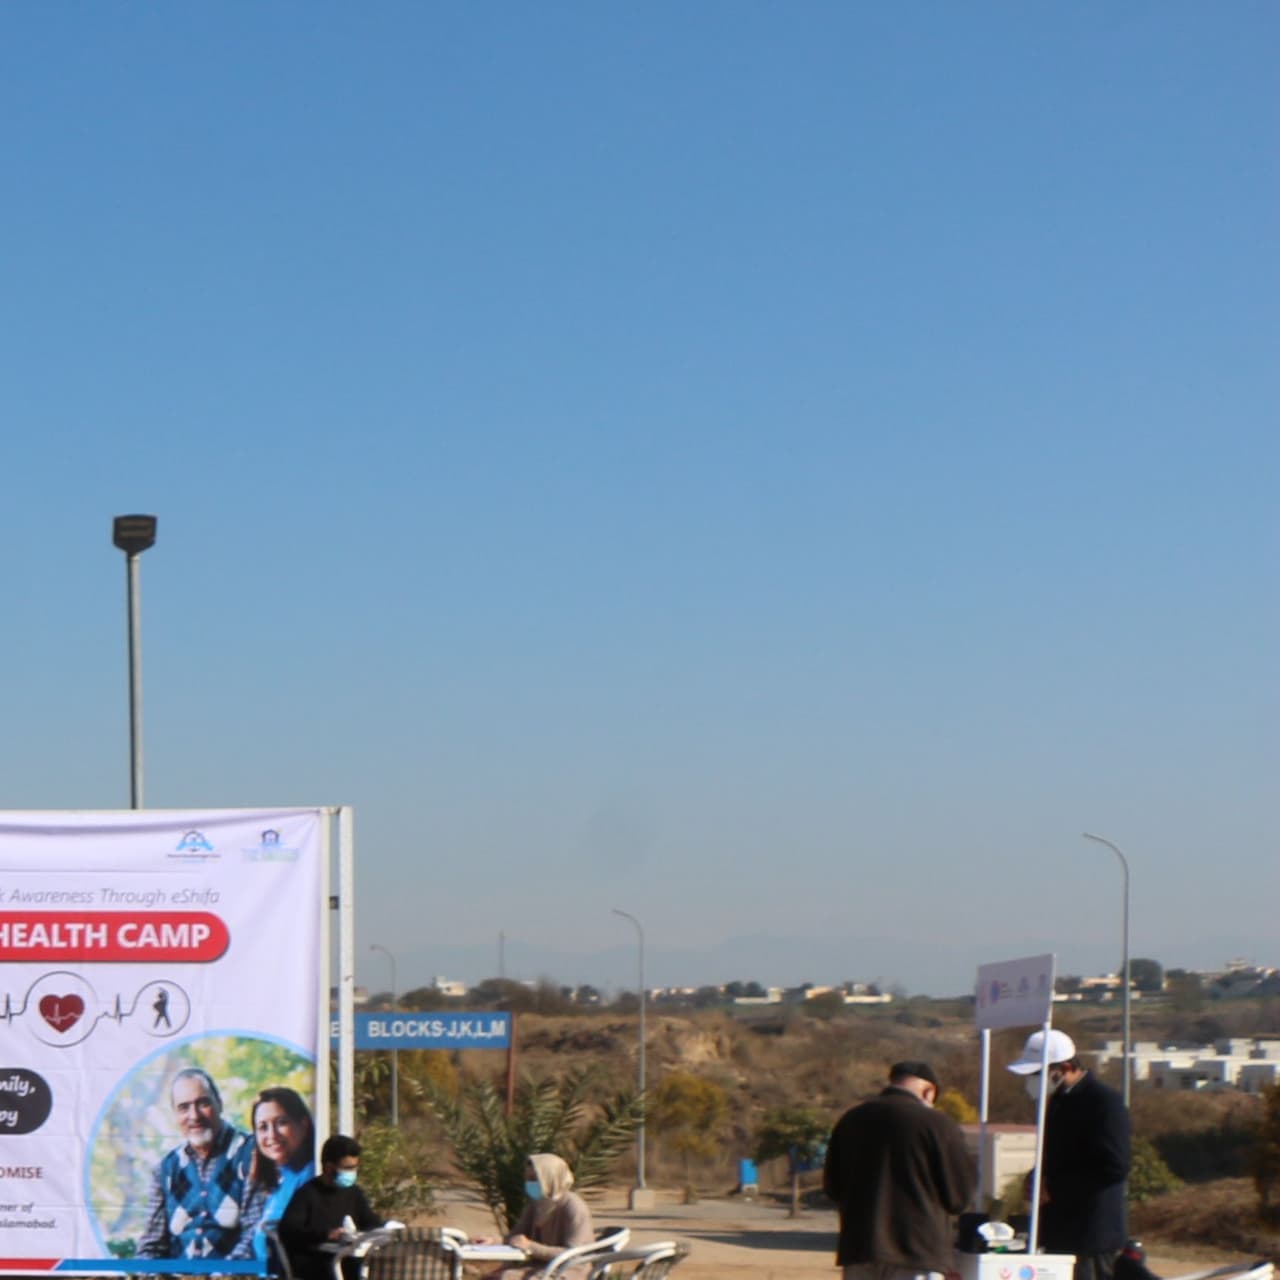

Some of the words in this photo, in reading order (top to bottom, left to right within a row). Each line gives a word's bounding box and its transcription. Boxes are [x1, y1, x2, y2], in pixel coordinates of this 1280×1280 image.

[8, 888, 94, 903] Awareness
[101, 888, 167, 908] Through
[171, 887, 221, 906] eShifa
[116, 922, 212, 949] CAMP
[21, 1202, 35, 1214] of
